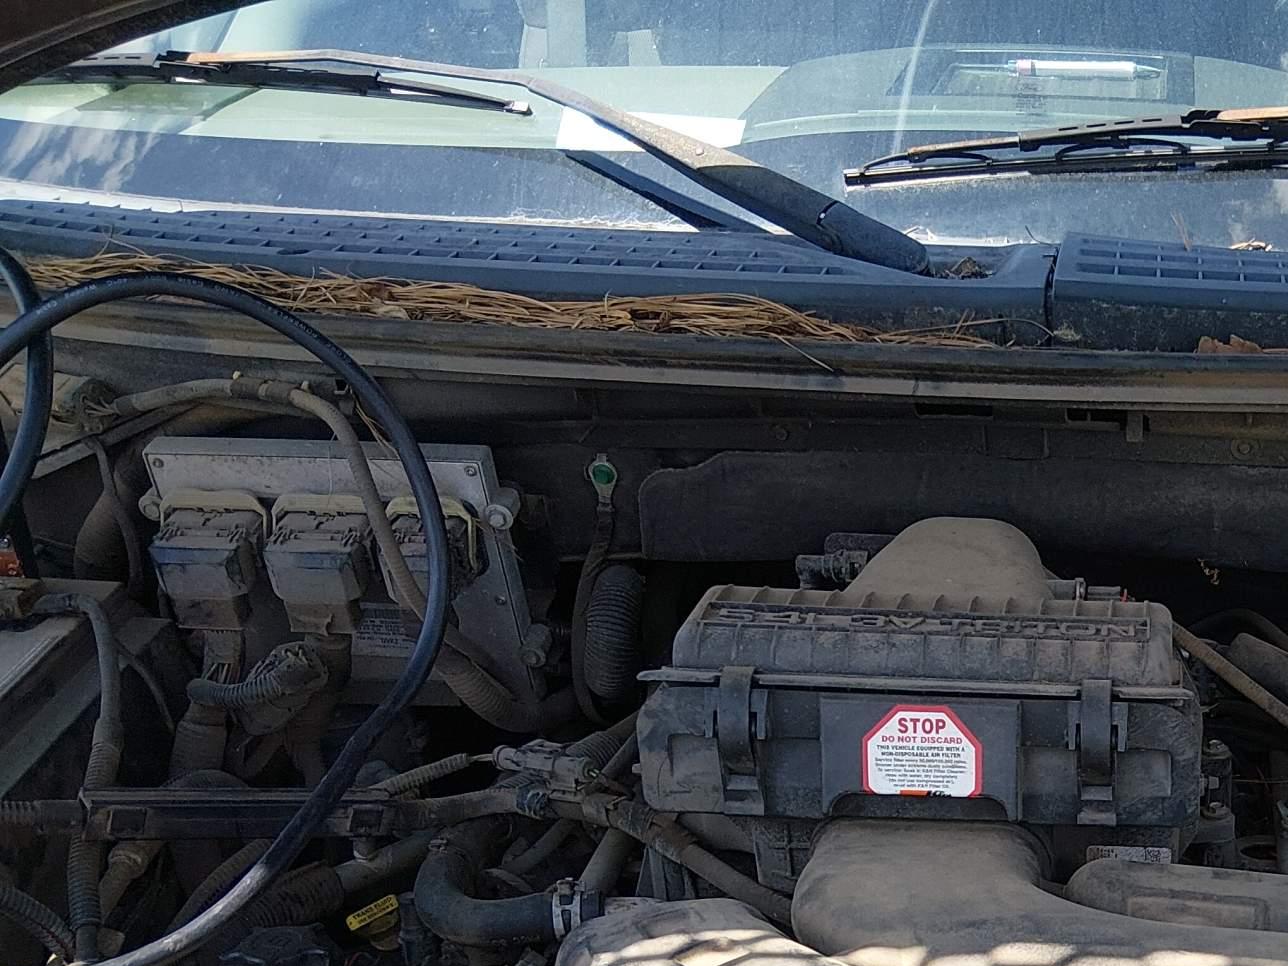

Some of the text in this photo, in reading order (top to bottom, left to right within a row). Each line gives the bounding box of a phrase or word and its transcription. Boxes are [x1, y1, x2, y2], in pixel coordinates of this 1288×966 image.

[851, 613, 925, 630] 3V
[940, 617, 1137, 637] TRITON
[897, 717, 947, 735] STOP
[881, 735, 963, 745] DO NOT DISCARD
